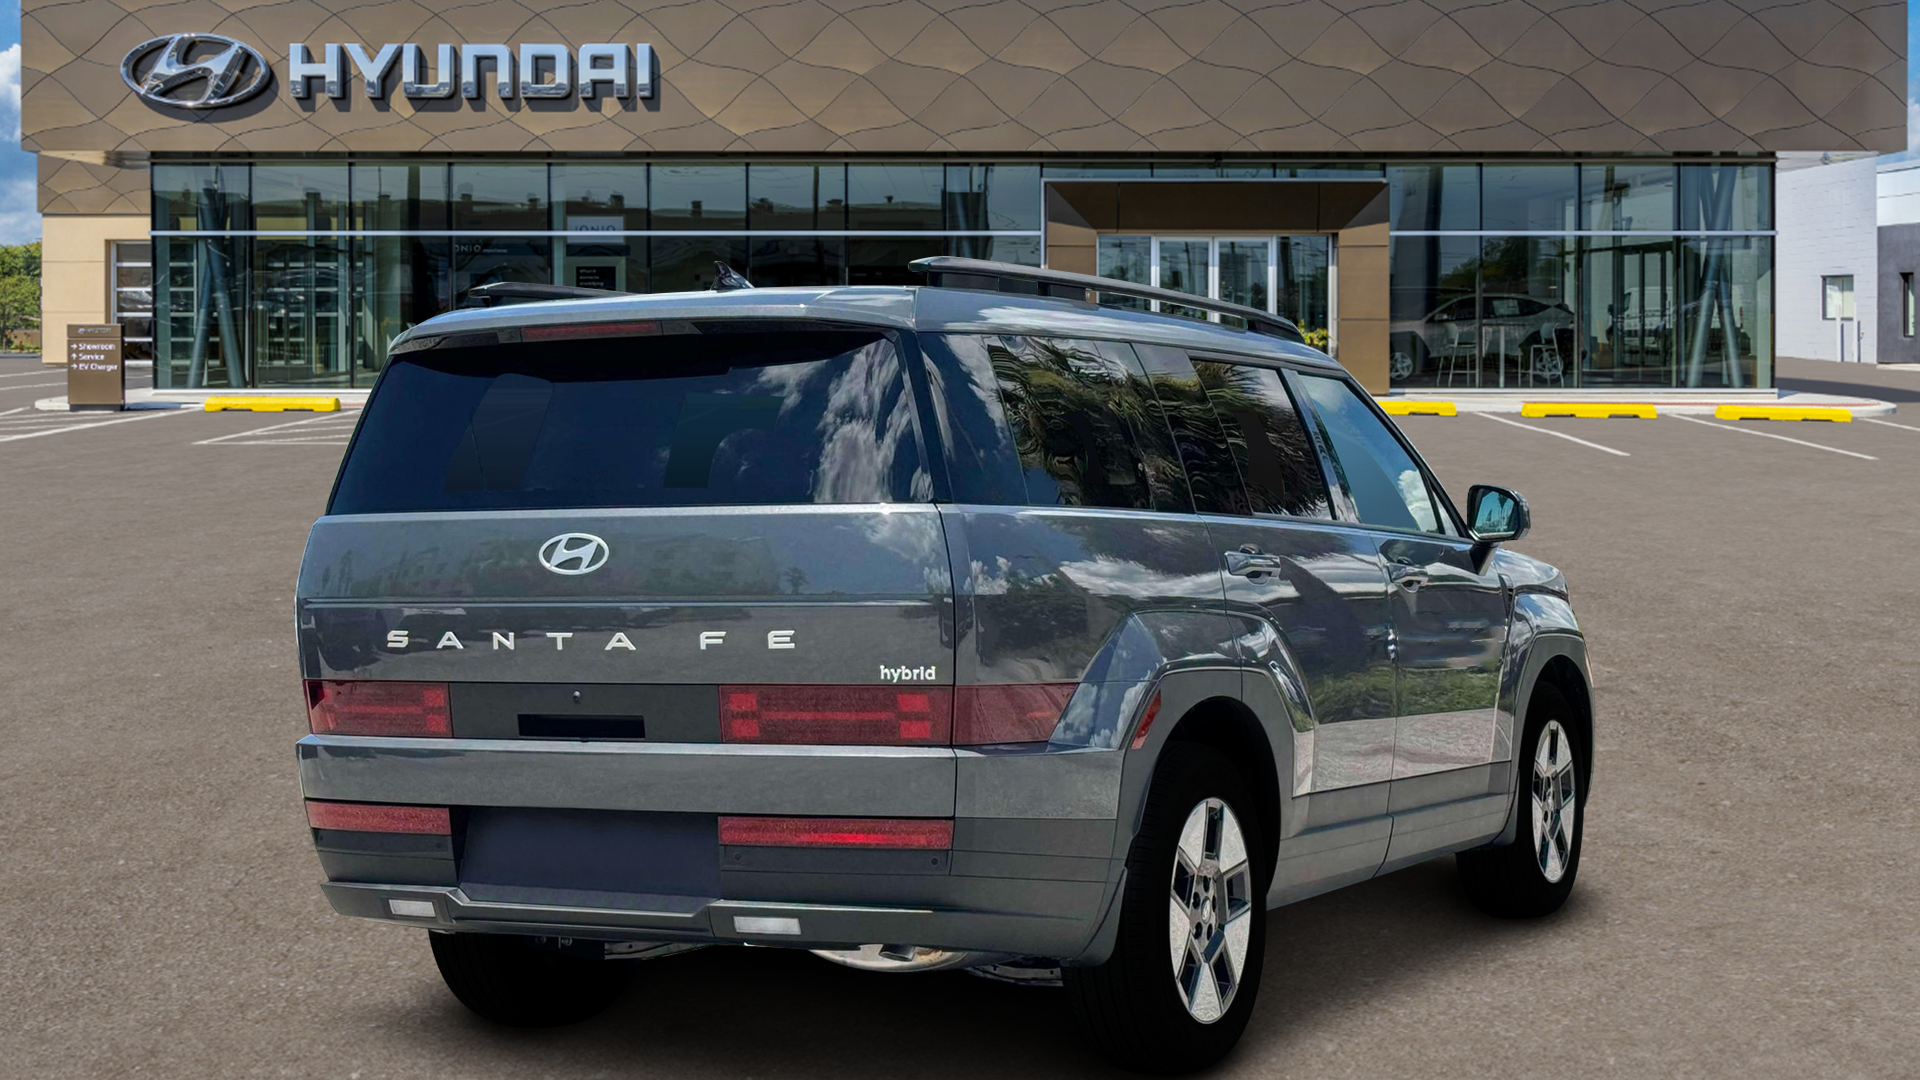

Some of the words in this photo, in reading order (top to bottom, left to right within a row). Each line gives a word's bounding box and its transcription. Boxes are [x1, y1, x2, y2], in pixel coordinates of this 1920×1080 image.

[289, 43, 656, 99] HYUNDAI
[90, 363, 118, 372] Charger
[387, 630, 637, 651] SANTA
[700, 630, 796, 651] FE
[880, 664, 936, 683] hybrid
